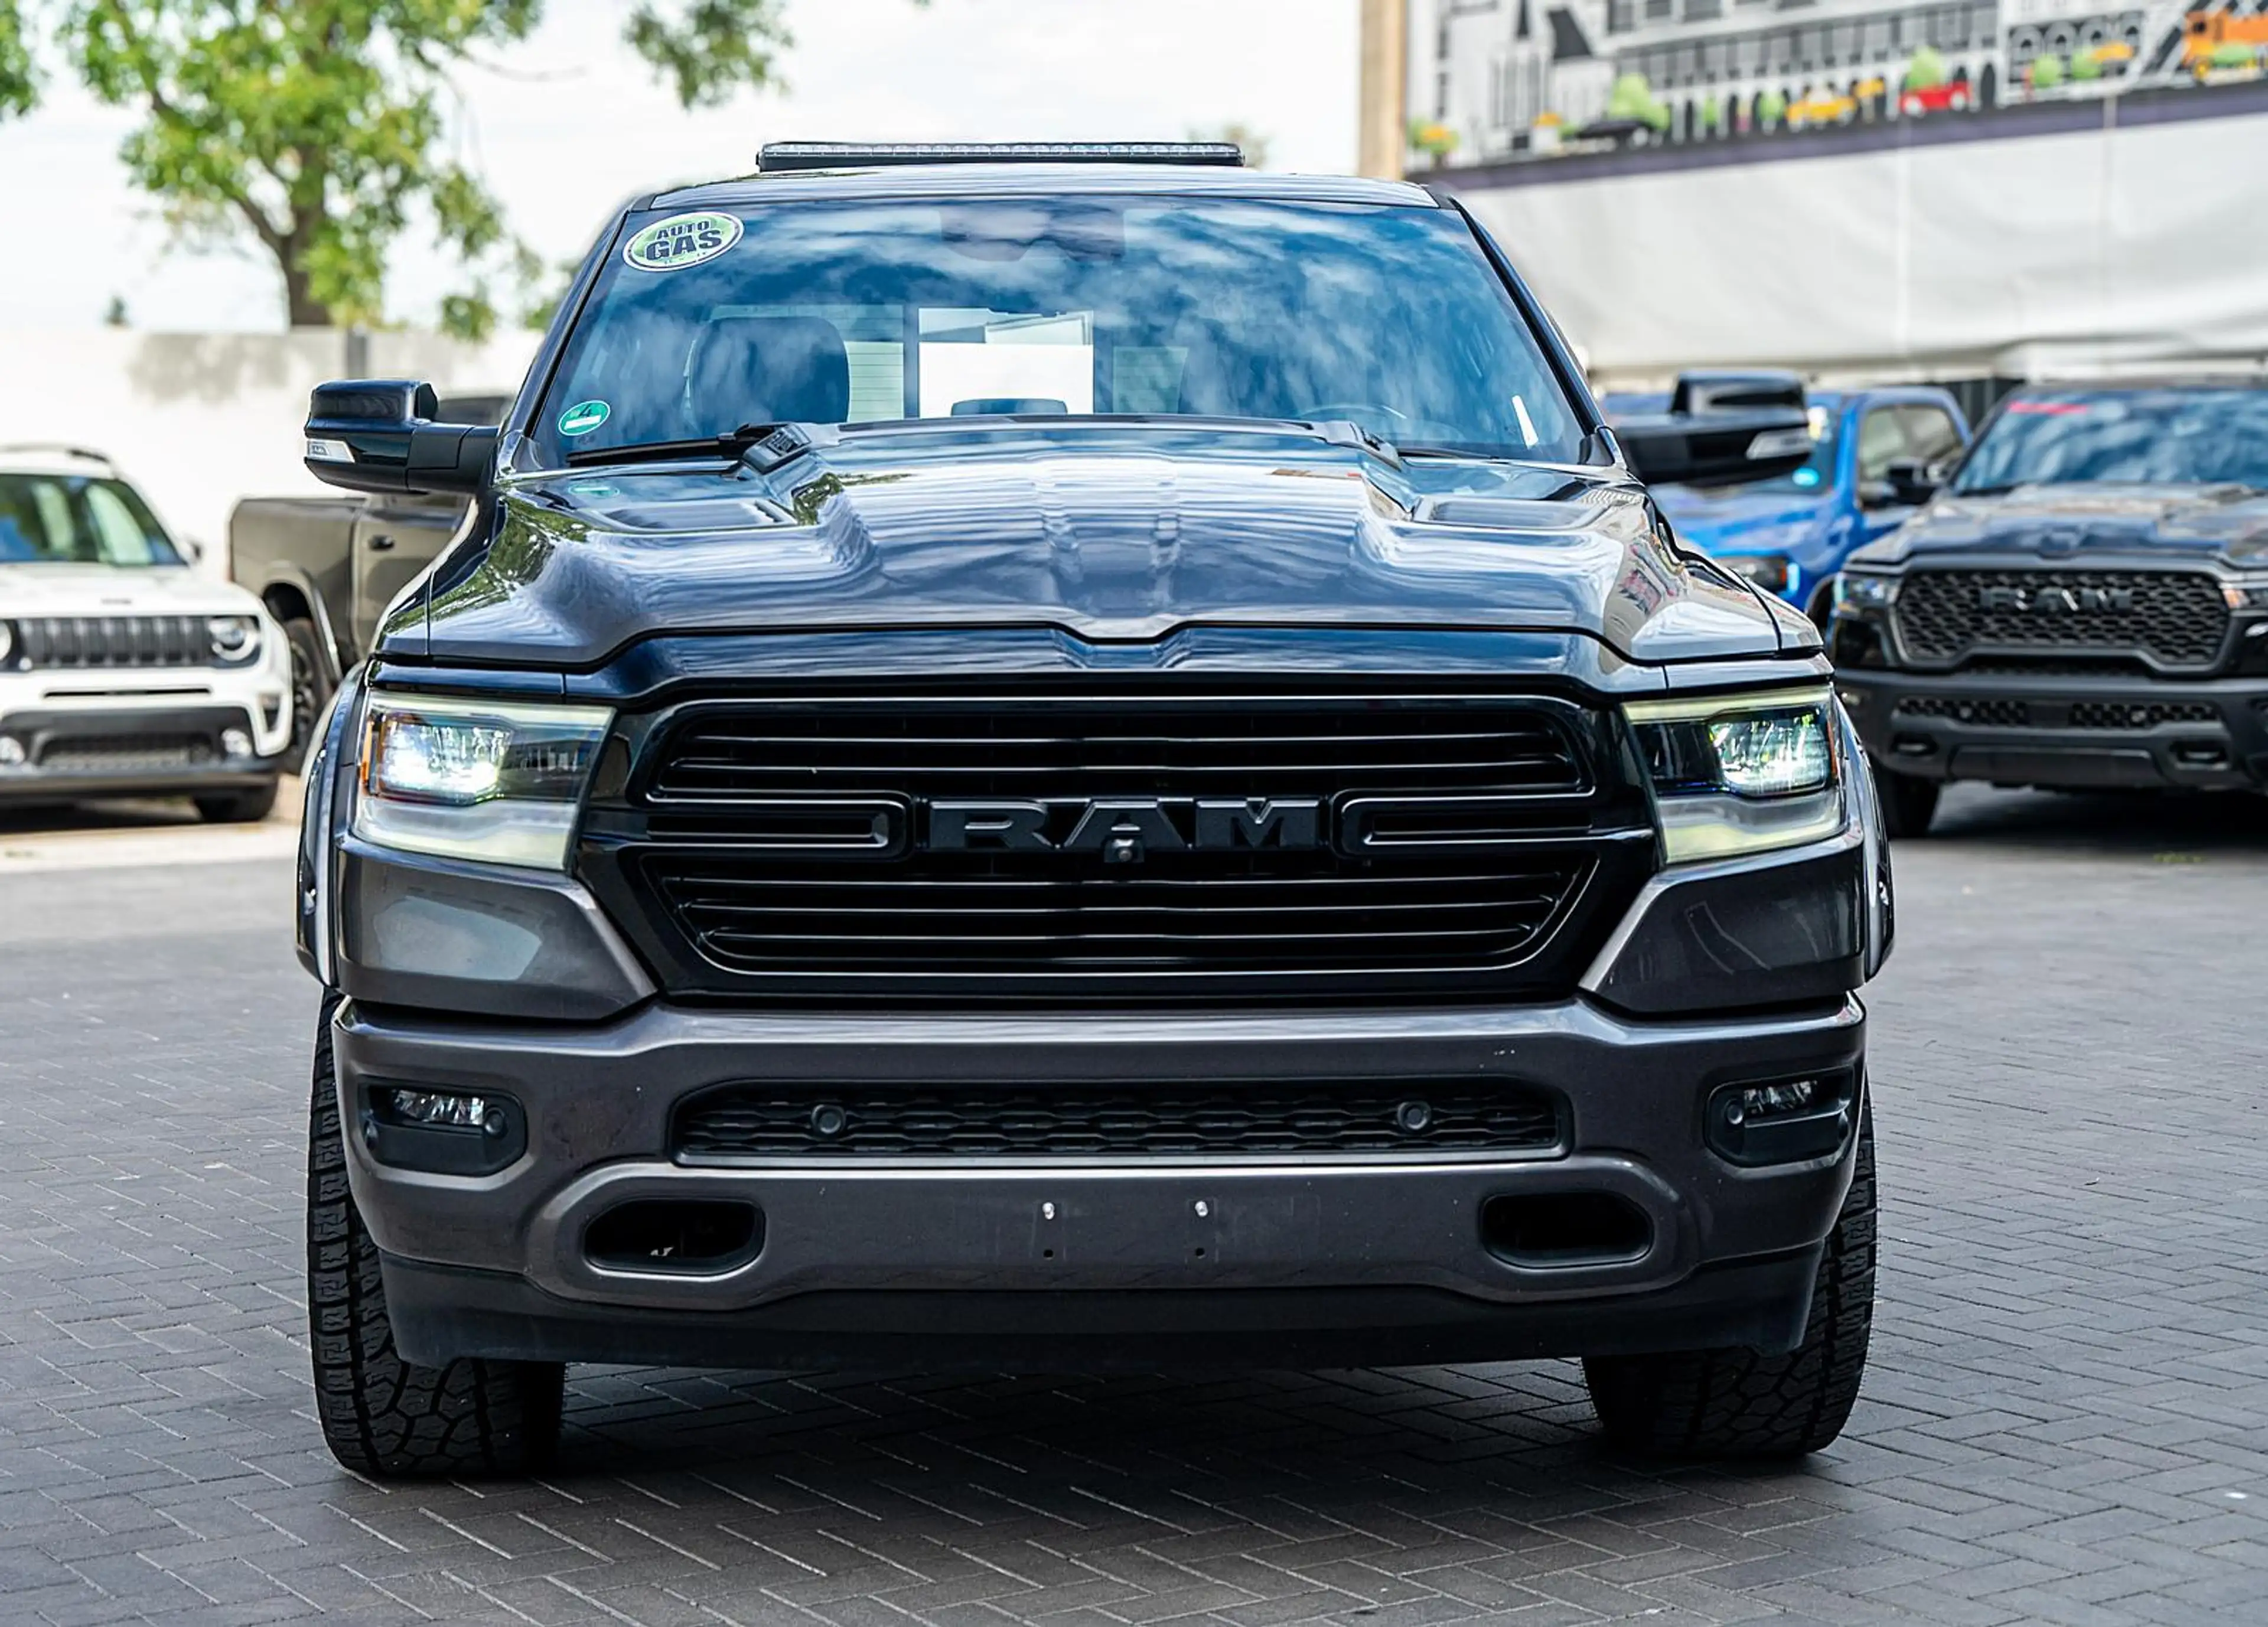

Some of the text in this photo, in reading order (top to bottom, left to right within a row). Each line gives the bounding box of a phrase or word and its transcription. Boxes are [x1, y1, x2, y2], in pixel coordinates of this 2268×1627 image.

[646, 230, 722, 260] GAS
[656, 221, 710, 240] AUTO
[930, 800, 1319, 849] RAM
